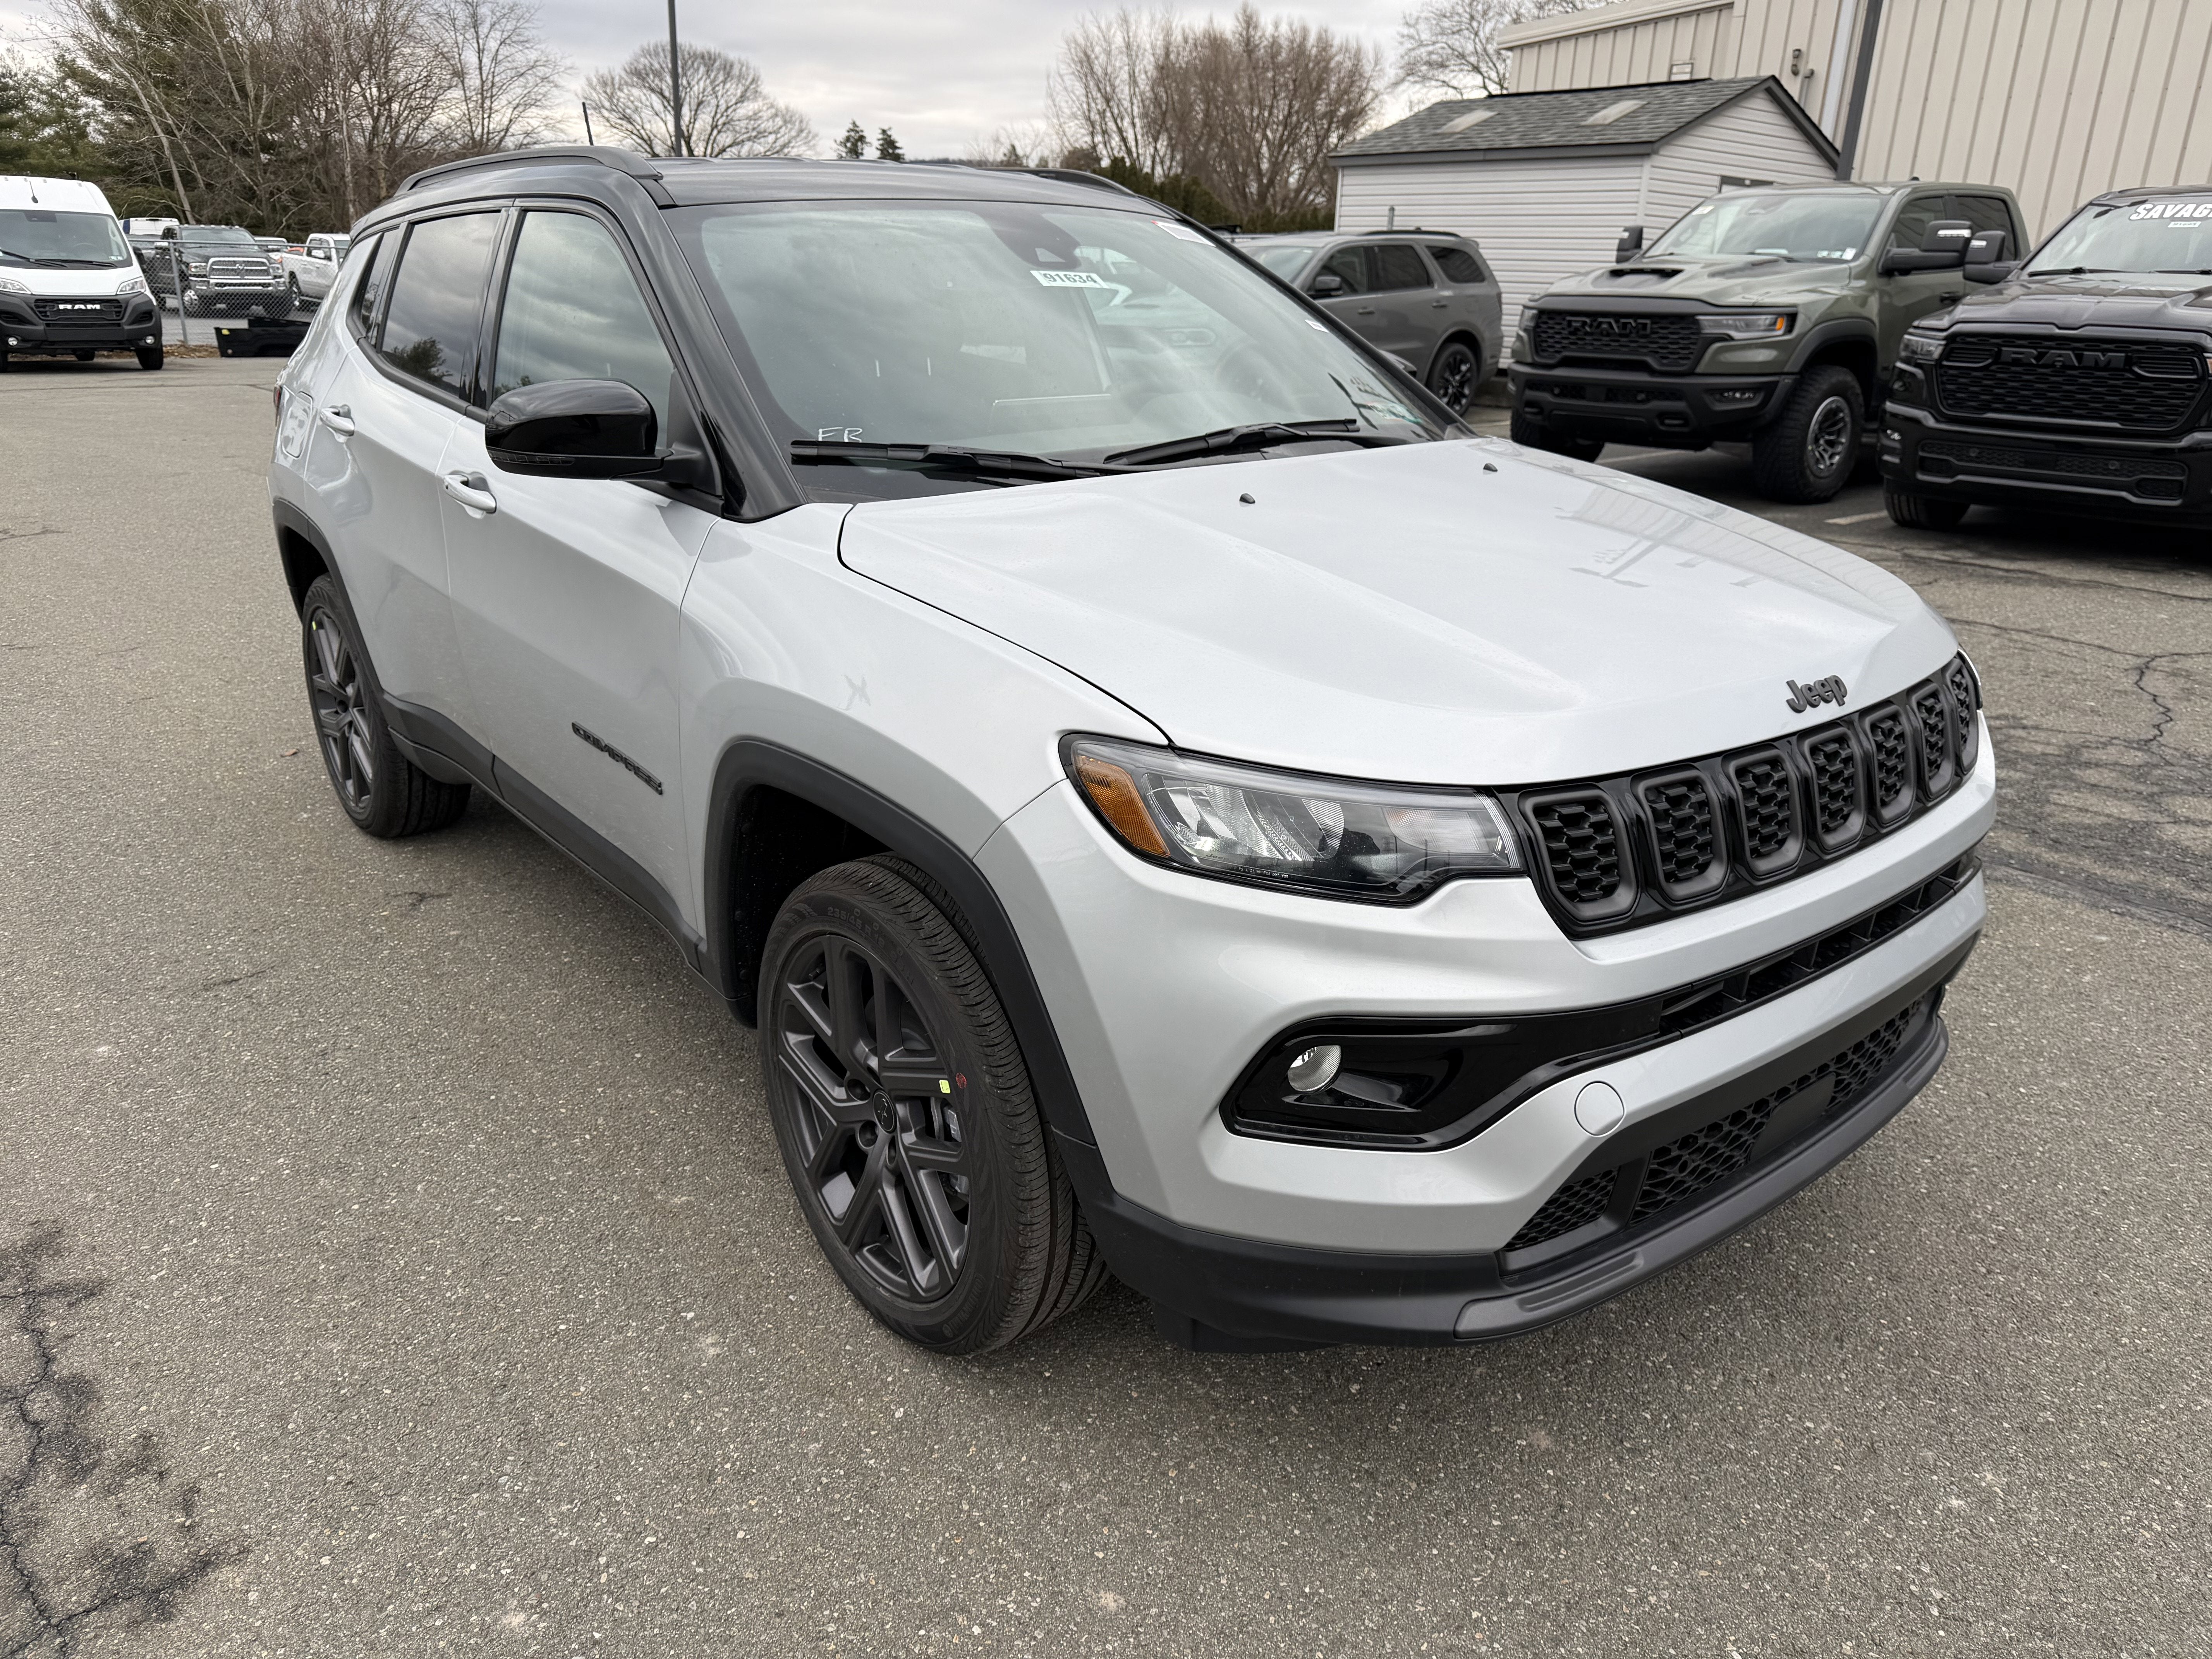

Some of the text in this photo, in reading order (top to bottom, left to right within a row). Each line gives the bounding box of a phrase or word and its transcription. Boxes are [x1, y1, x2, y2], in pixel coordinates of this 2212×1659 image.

[2130, 204, 2212, 220] SAVAG
[1042, 273, 1097, 283] 91634
[1565, 316, 1651, 336] RAM
[1998, 347, 2125, 368] RAM
[1786, 675, 1848, 714] Jeep
[571, 721, 663, 795] COMPASS
